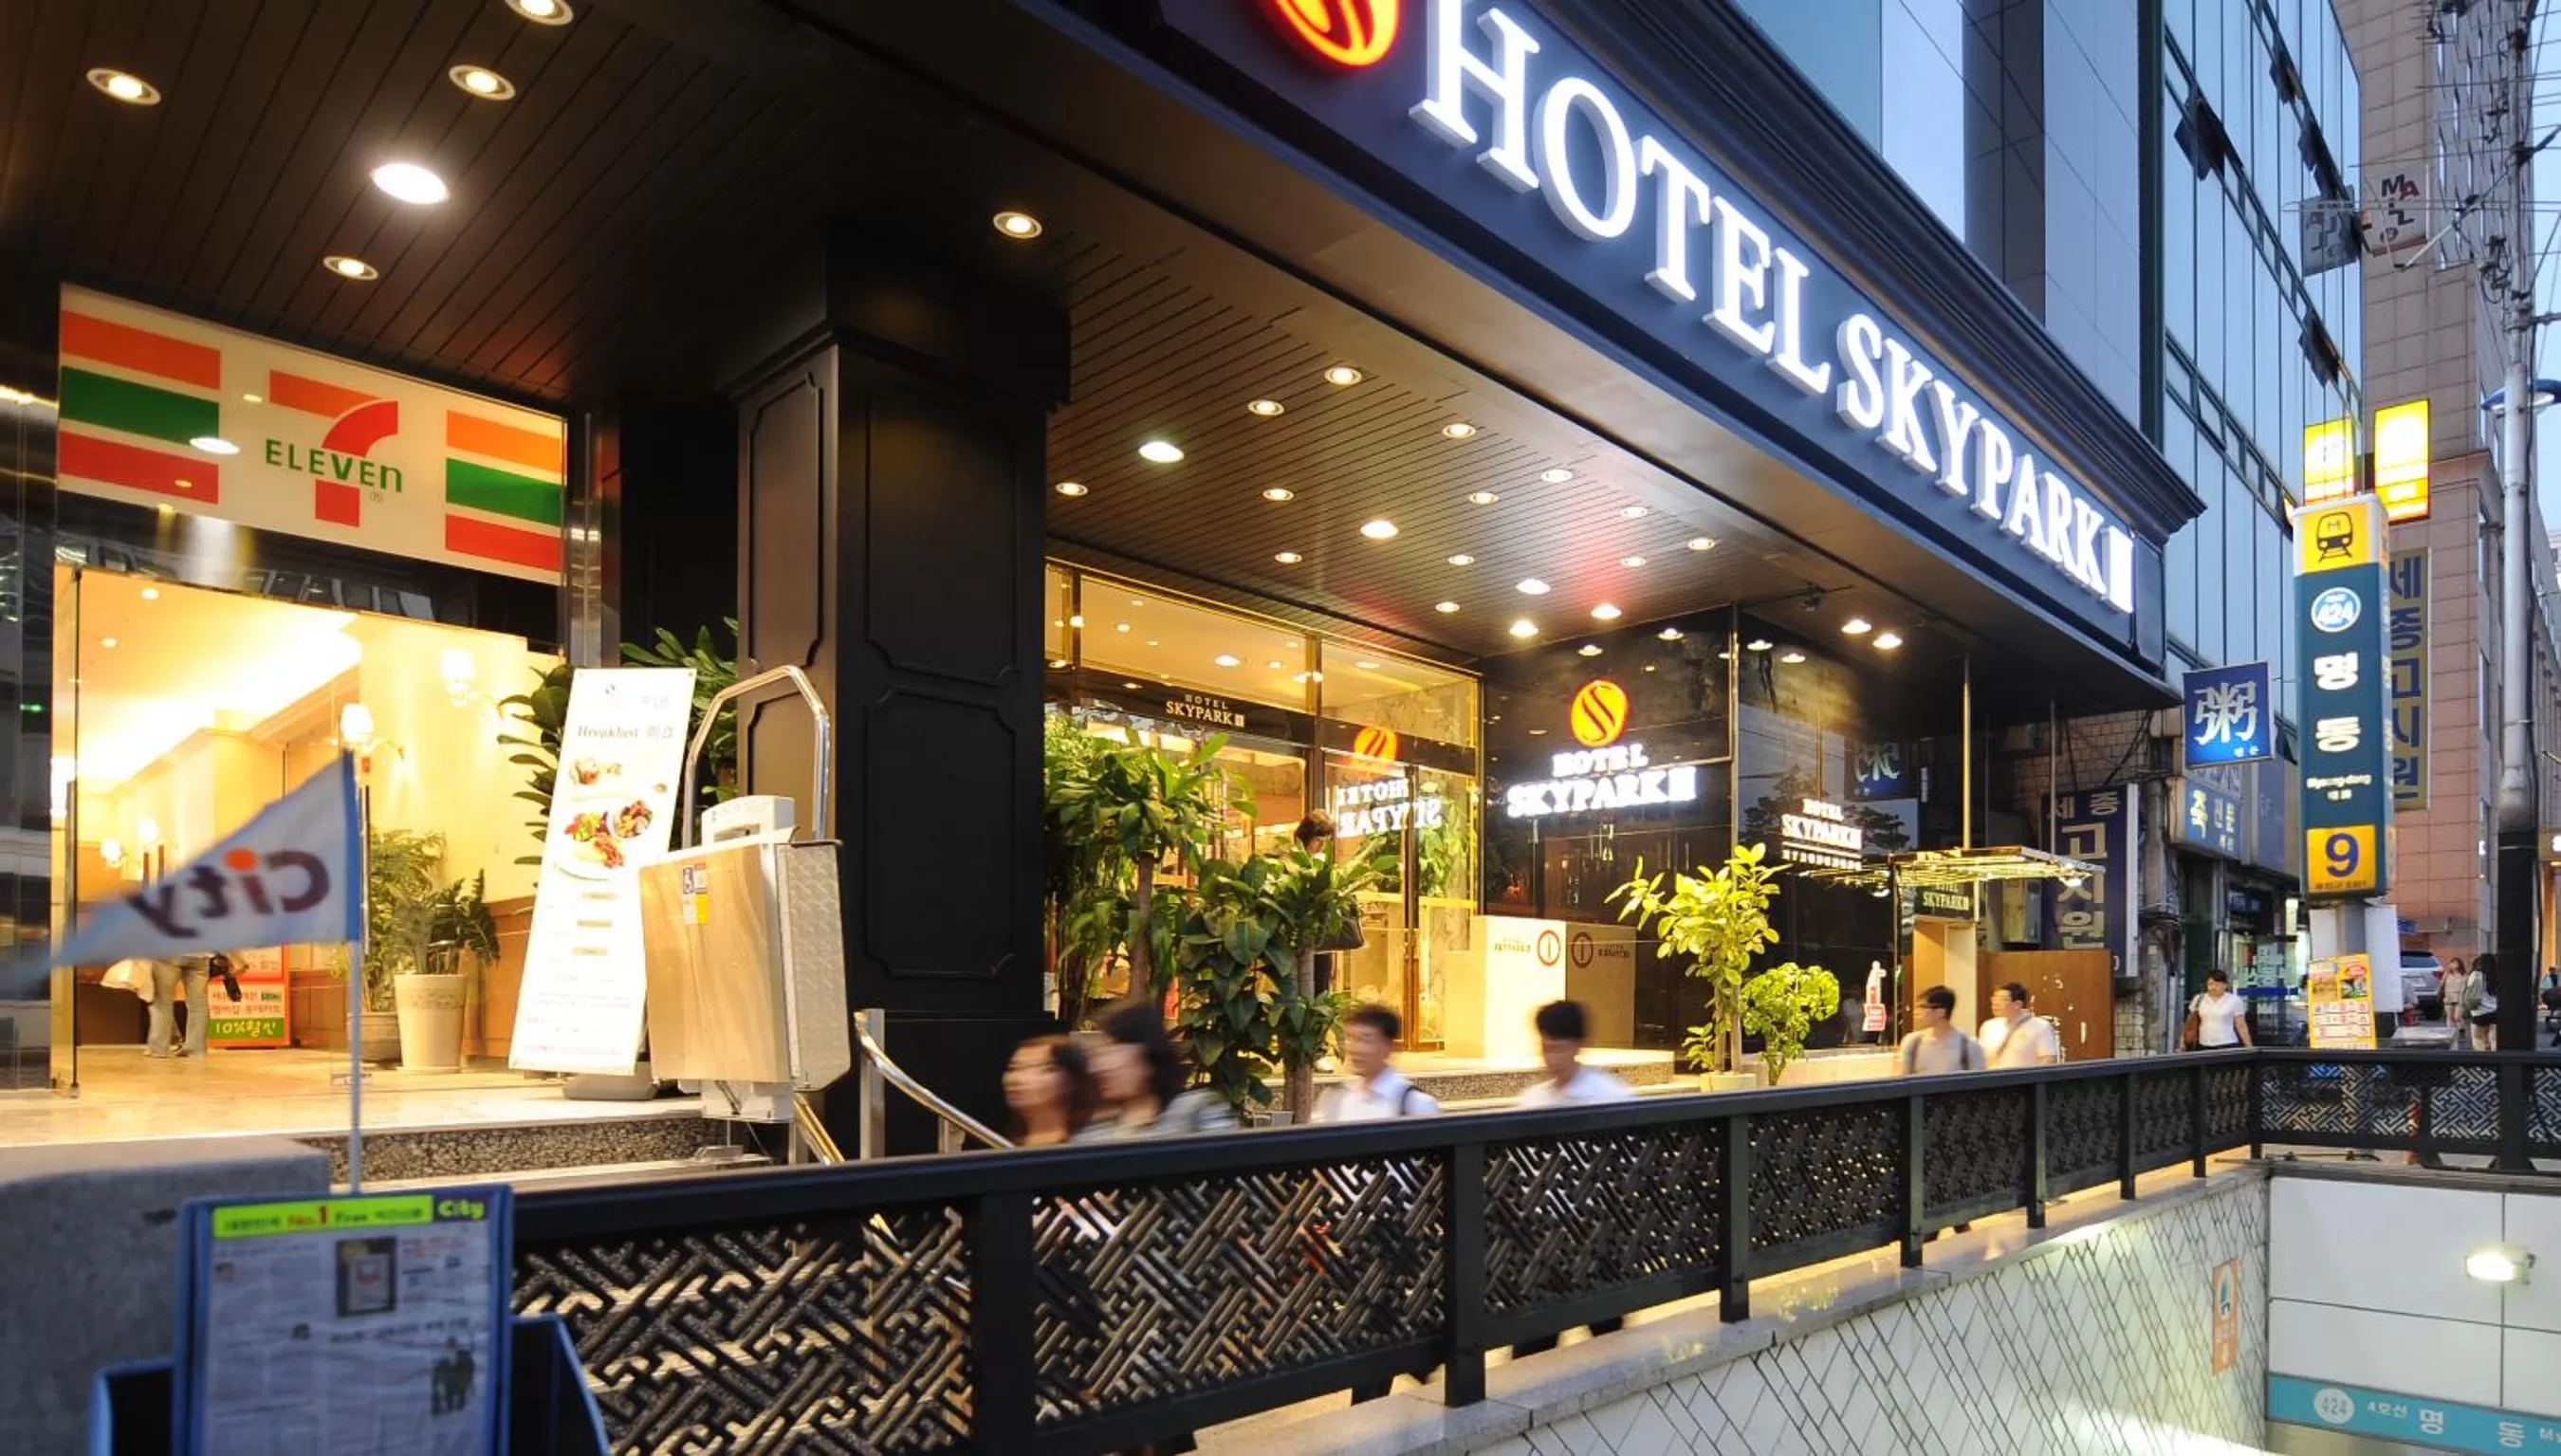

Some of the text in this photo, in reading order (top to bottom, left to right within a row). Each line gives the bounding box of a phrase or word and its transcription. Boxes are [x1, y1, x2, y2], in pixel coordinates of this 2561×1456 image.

[1409, 0, 1830, 395] HOTEL
[1185, 694, 1228, 710] HOTEL
[2194, 680, 2257, 746] 粥
[578, 725, 638, 738] Breakfast
[1552, 743, 1649, 778] HOTEL
[2325, 832, 2359, 878] 9
[437, 1199, 485, 1219] City
